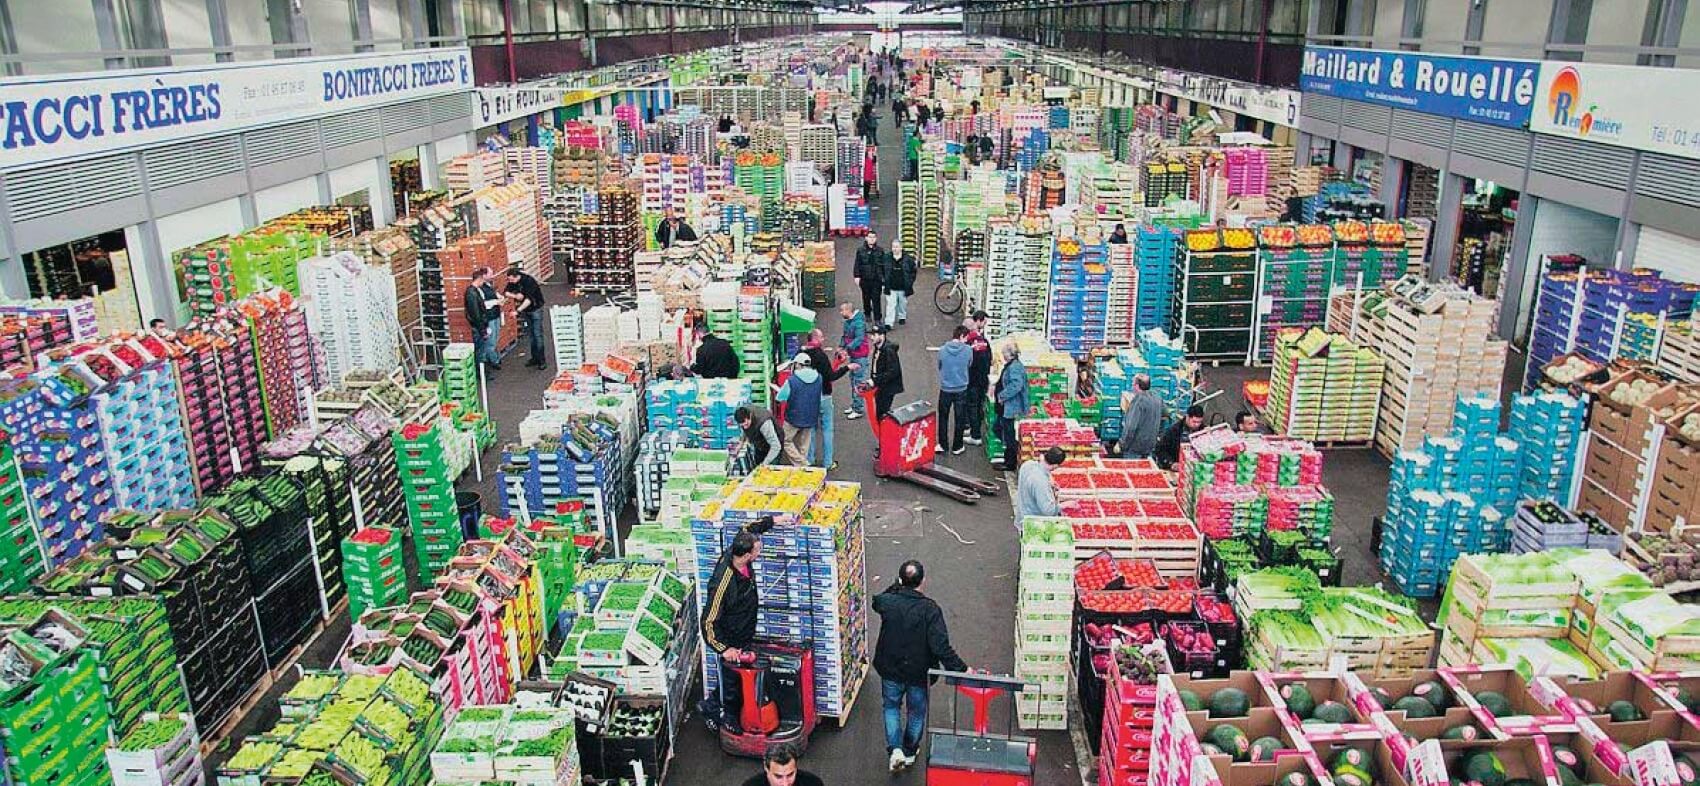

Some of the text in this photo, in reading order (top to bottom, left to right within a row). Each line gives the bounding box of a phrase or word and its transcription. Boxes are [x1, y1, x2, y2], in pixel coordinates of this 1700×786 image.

[323, 64, 407, 101] BONIFACCI
[412, 55, 455, 88] FRÈRES
[1302, 51, 1382, 85] Maillard
[1389, 58, 1404, 88] &
[1415, 60, 1534, 106] Rouellé
[0, 78, 221, 149] ACCI FRÈRES
